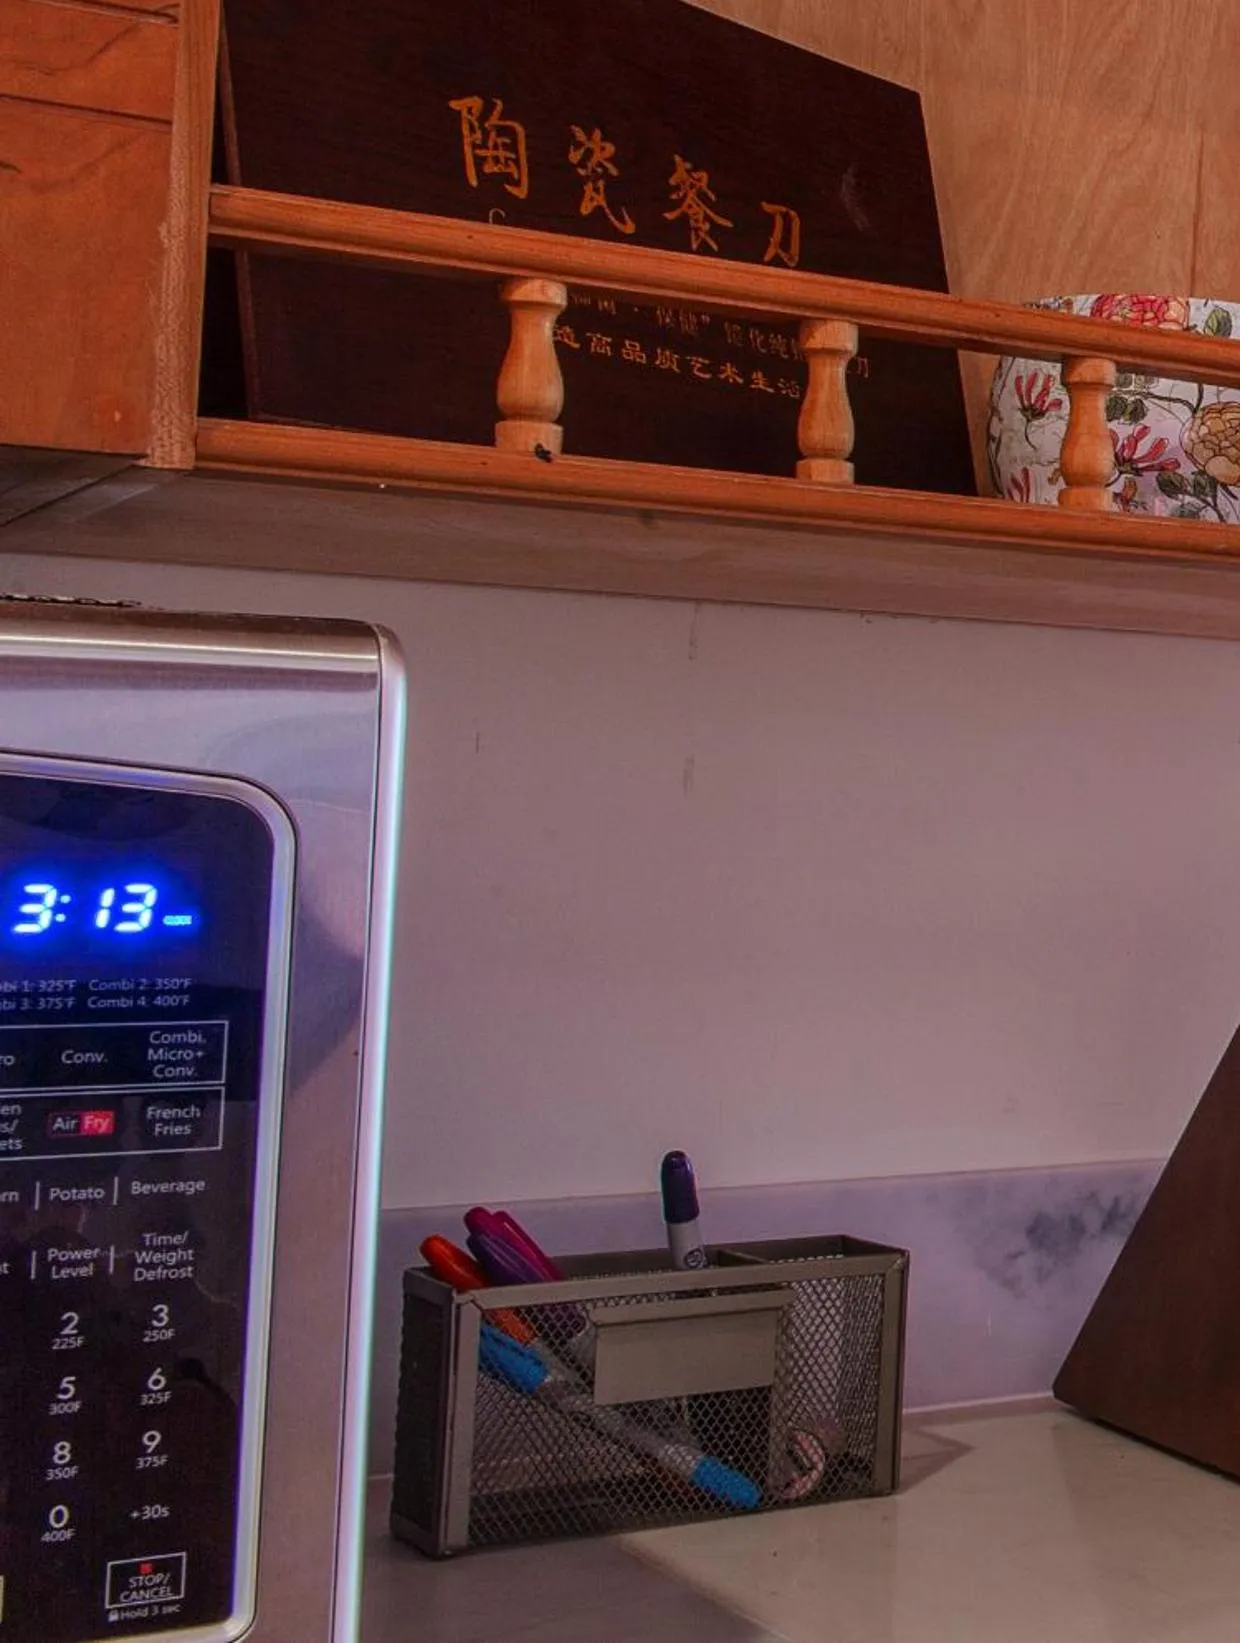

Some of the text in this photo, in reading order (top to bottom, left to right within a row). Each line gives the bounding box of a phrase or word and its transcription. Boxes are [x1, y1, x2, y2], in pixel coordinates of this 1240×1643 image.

[448, 96, 802, 267] 陶瓷餐刀
[12, 882, 157, 934] 3:13
[88, 977, 135, 992] Combi
[87, 995, 134, 1009] Combi
[60, 1049, 109, 1064] Conv.
[146, 1103, 201, 1120] French
[52, 1113, 111, 1133] Air Fry
[154, 1120, 192, 1136] Fries
[49, 1186, 105, 1201] Potato
[130, 1179, 206, 1196] Beverage
[142, 1230, 190, 1247] Time/
[47, 1246, 100, 1261] Power
[134, 1247, 195, 1266] Weight
[51, 1262, 95, 1280] Level
[133, 1264, 194, 1282] Defrost
[60, 1311, 80, 1335] 2
[151, 1303, 170, 1328] 3
[57, 1375, 77, 1400] 5
[147, 1367, 167, 1391] 6
[142, 1429, 162, 1453] 9
[52, 1440, 72, 1465] 8
[49, 1504, 70, 1529] 0
[119, 1586, 174, 1603] CANCEL
[120, 1607, 149, 1622] Hold
